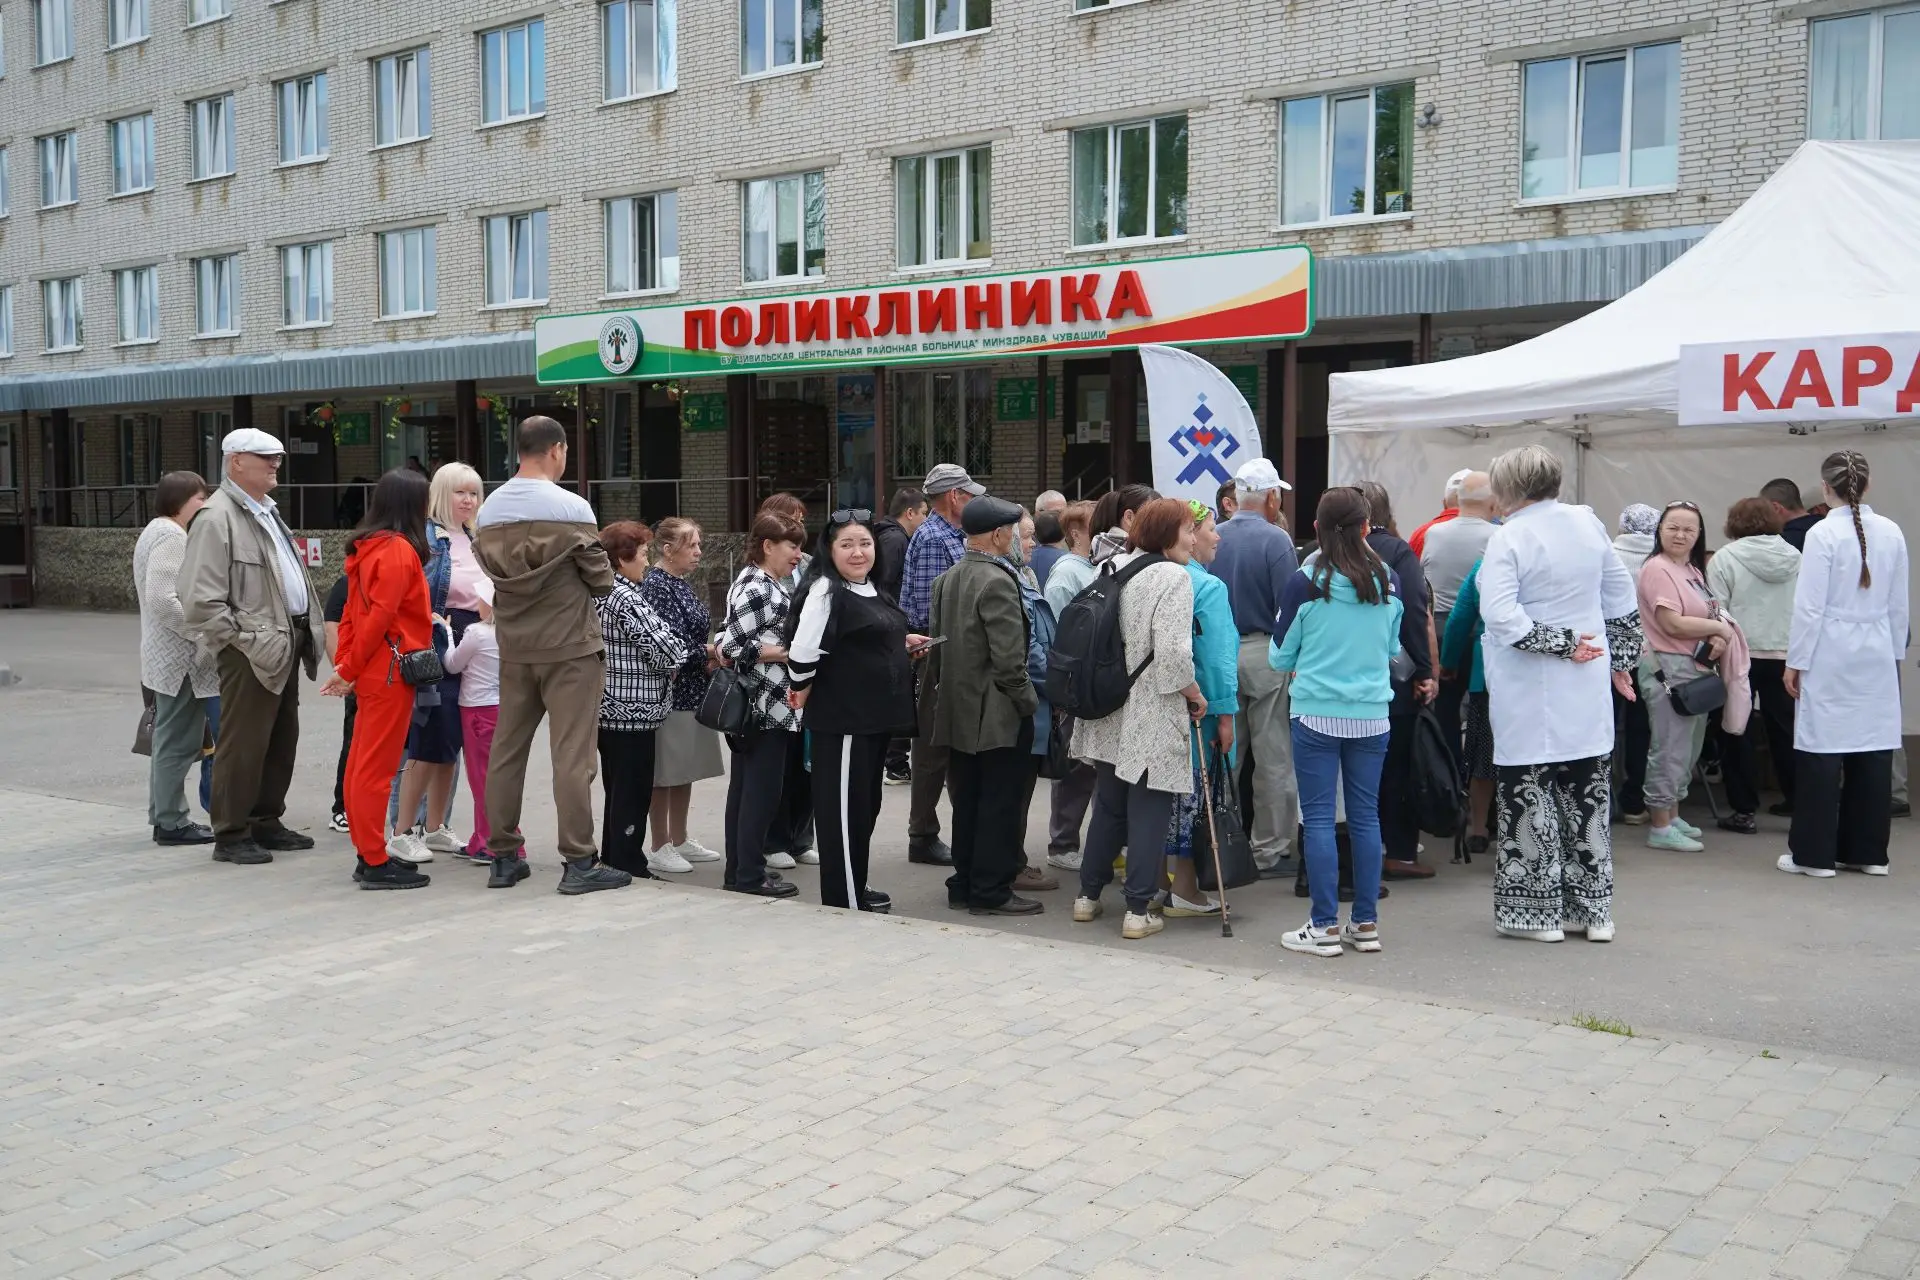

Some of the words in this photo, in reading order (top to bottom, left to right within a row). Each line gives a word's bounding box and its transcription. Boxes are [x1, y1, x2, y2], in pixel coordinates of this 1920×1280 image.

[684, 270, 1152, 350] ПОЛИКЛИНИКА
[721, 355, 733, 365] БУ
[799, 348, 862, 359] ЦЕНТРАЛЬНАЯ
[867, 343, 917, 355] РАЙОННАЯ
[983, 334, 1047, 347] МИНЗДРАВА
[1052, 330, 1107, 342] ЧУВАШИИ
